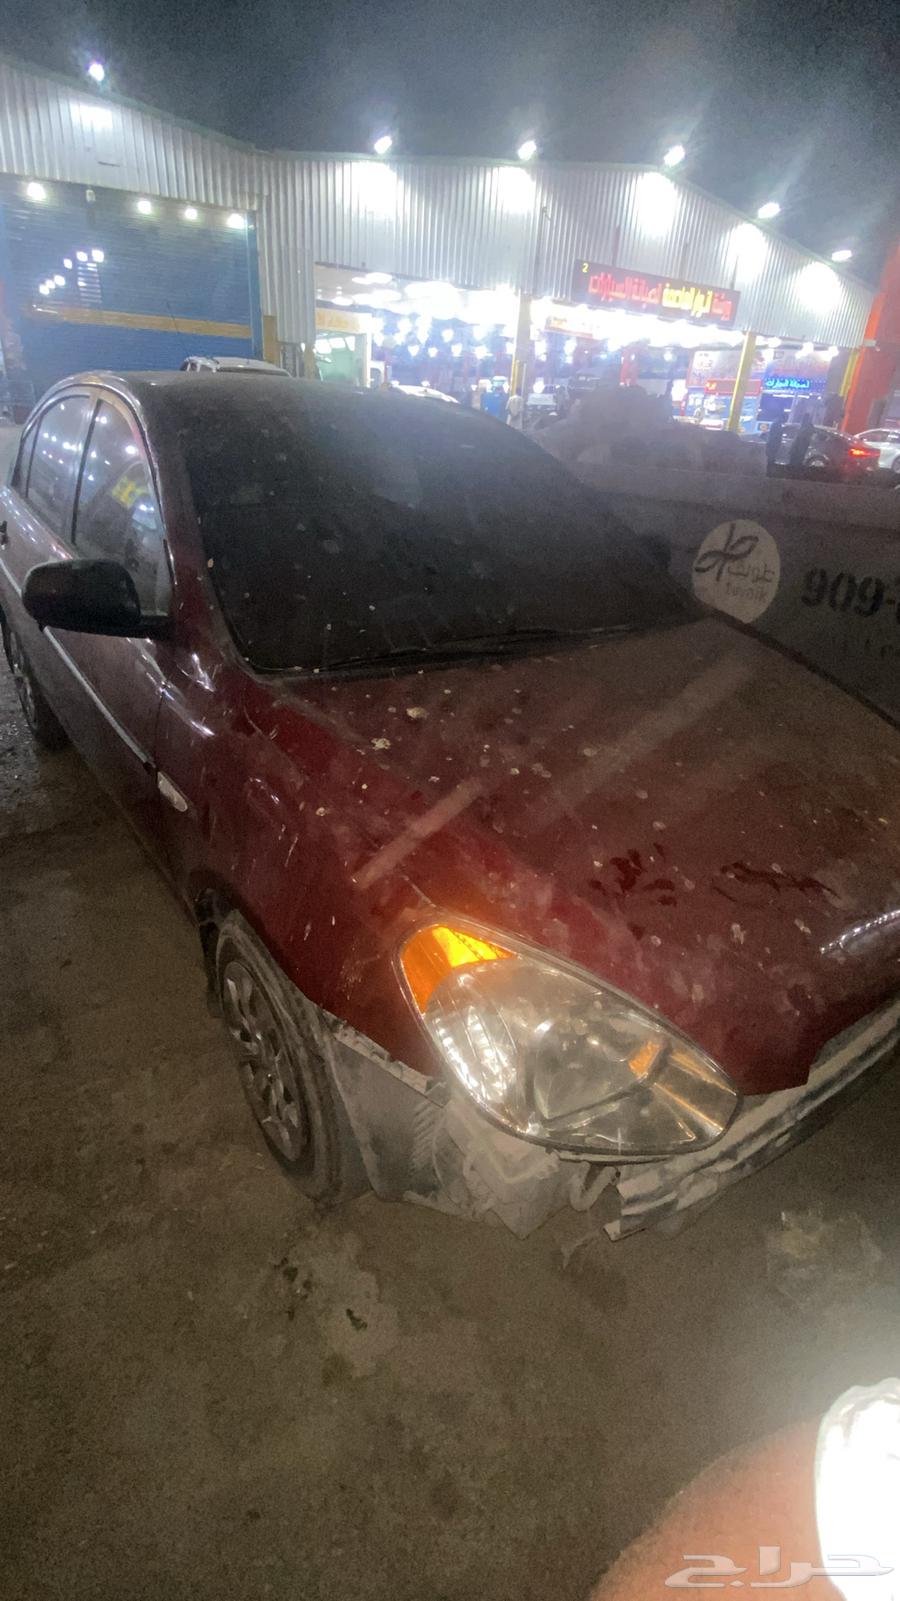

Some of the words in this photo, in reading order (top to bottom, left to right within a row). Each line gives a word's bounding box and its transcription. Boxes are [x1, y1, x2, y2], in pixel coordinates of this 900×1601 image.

[582, 262, 589, 273] 2
[588, 272, 632, 302] السيارات
[632, 277, 662, 309] لصيانة
[801, 567, 900, 624] 909-
